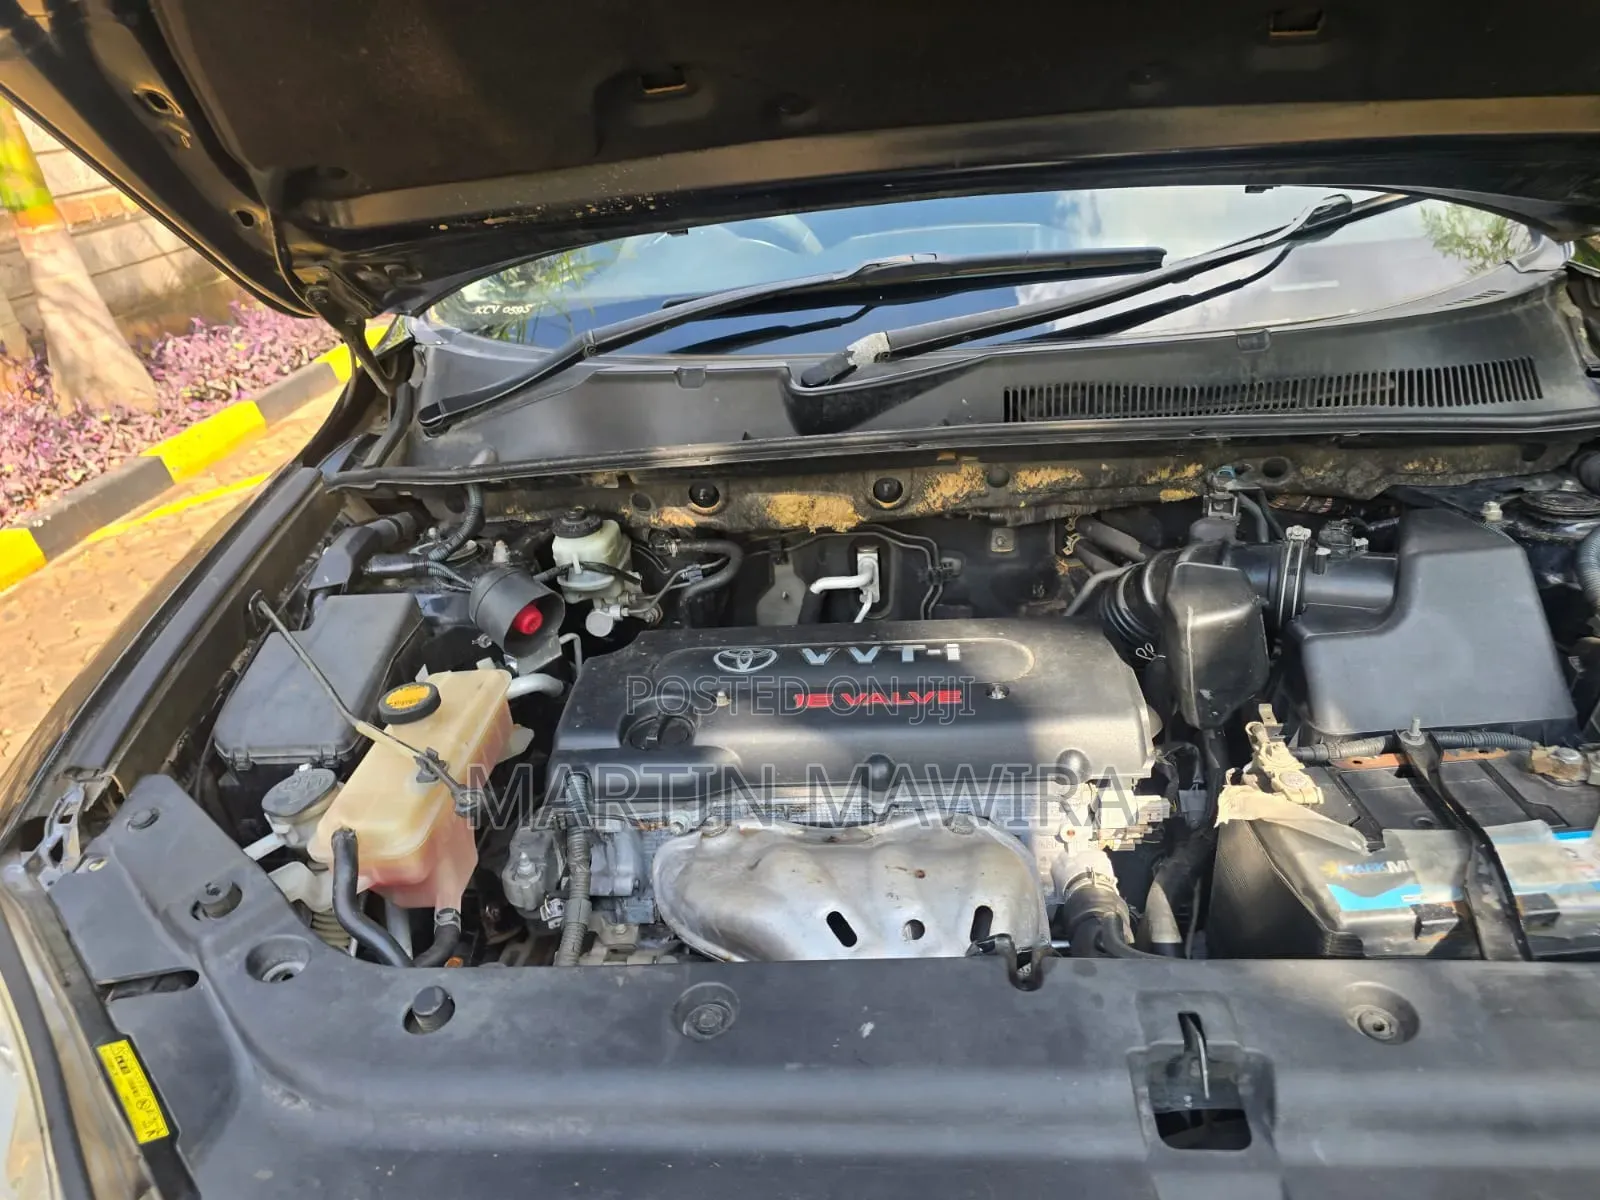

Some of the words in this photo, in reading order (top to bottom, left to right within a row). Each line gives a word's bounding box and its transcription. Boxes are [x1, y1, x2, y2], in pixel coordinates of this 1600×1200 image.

[472, 304, 500, 315] KCV
[794, 693, 834, 709] 16
[840, 690, 962, 705] VALVE
